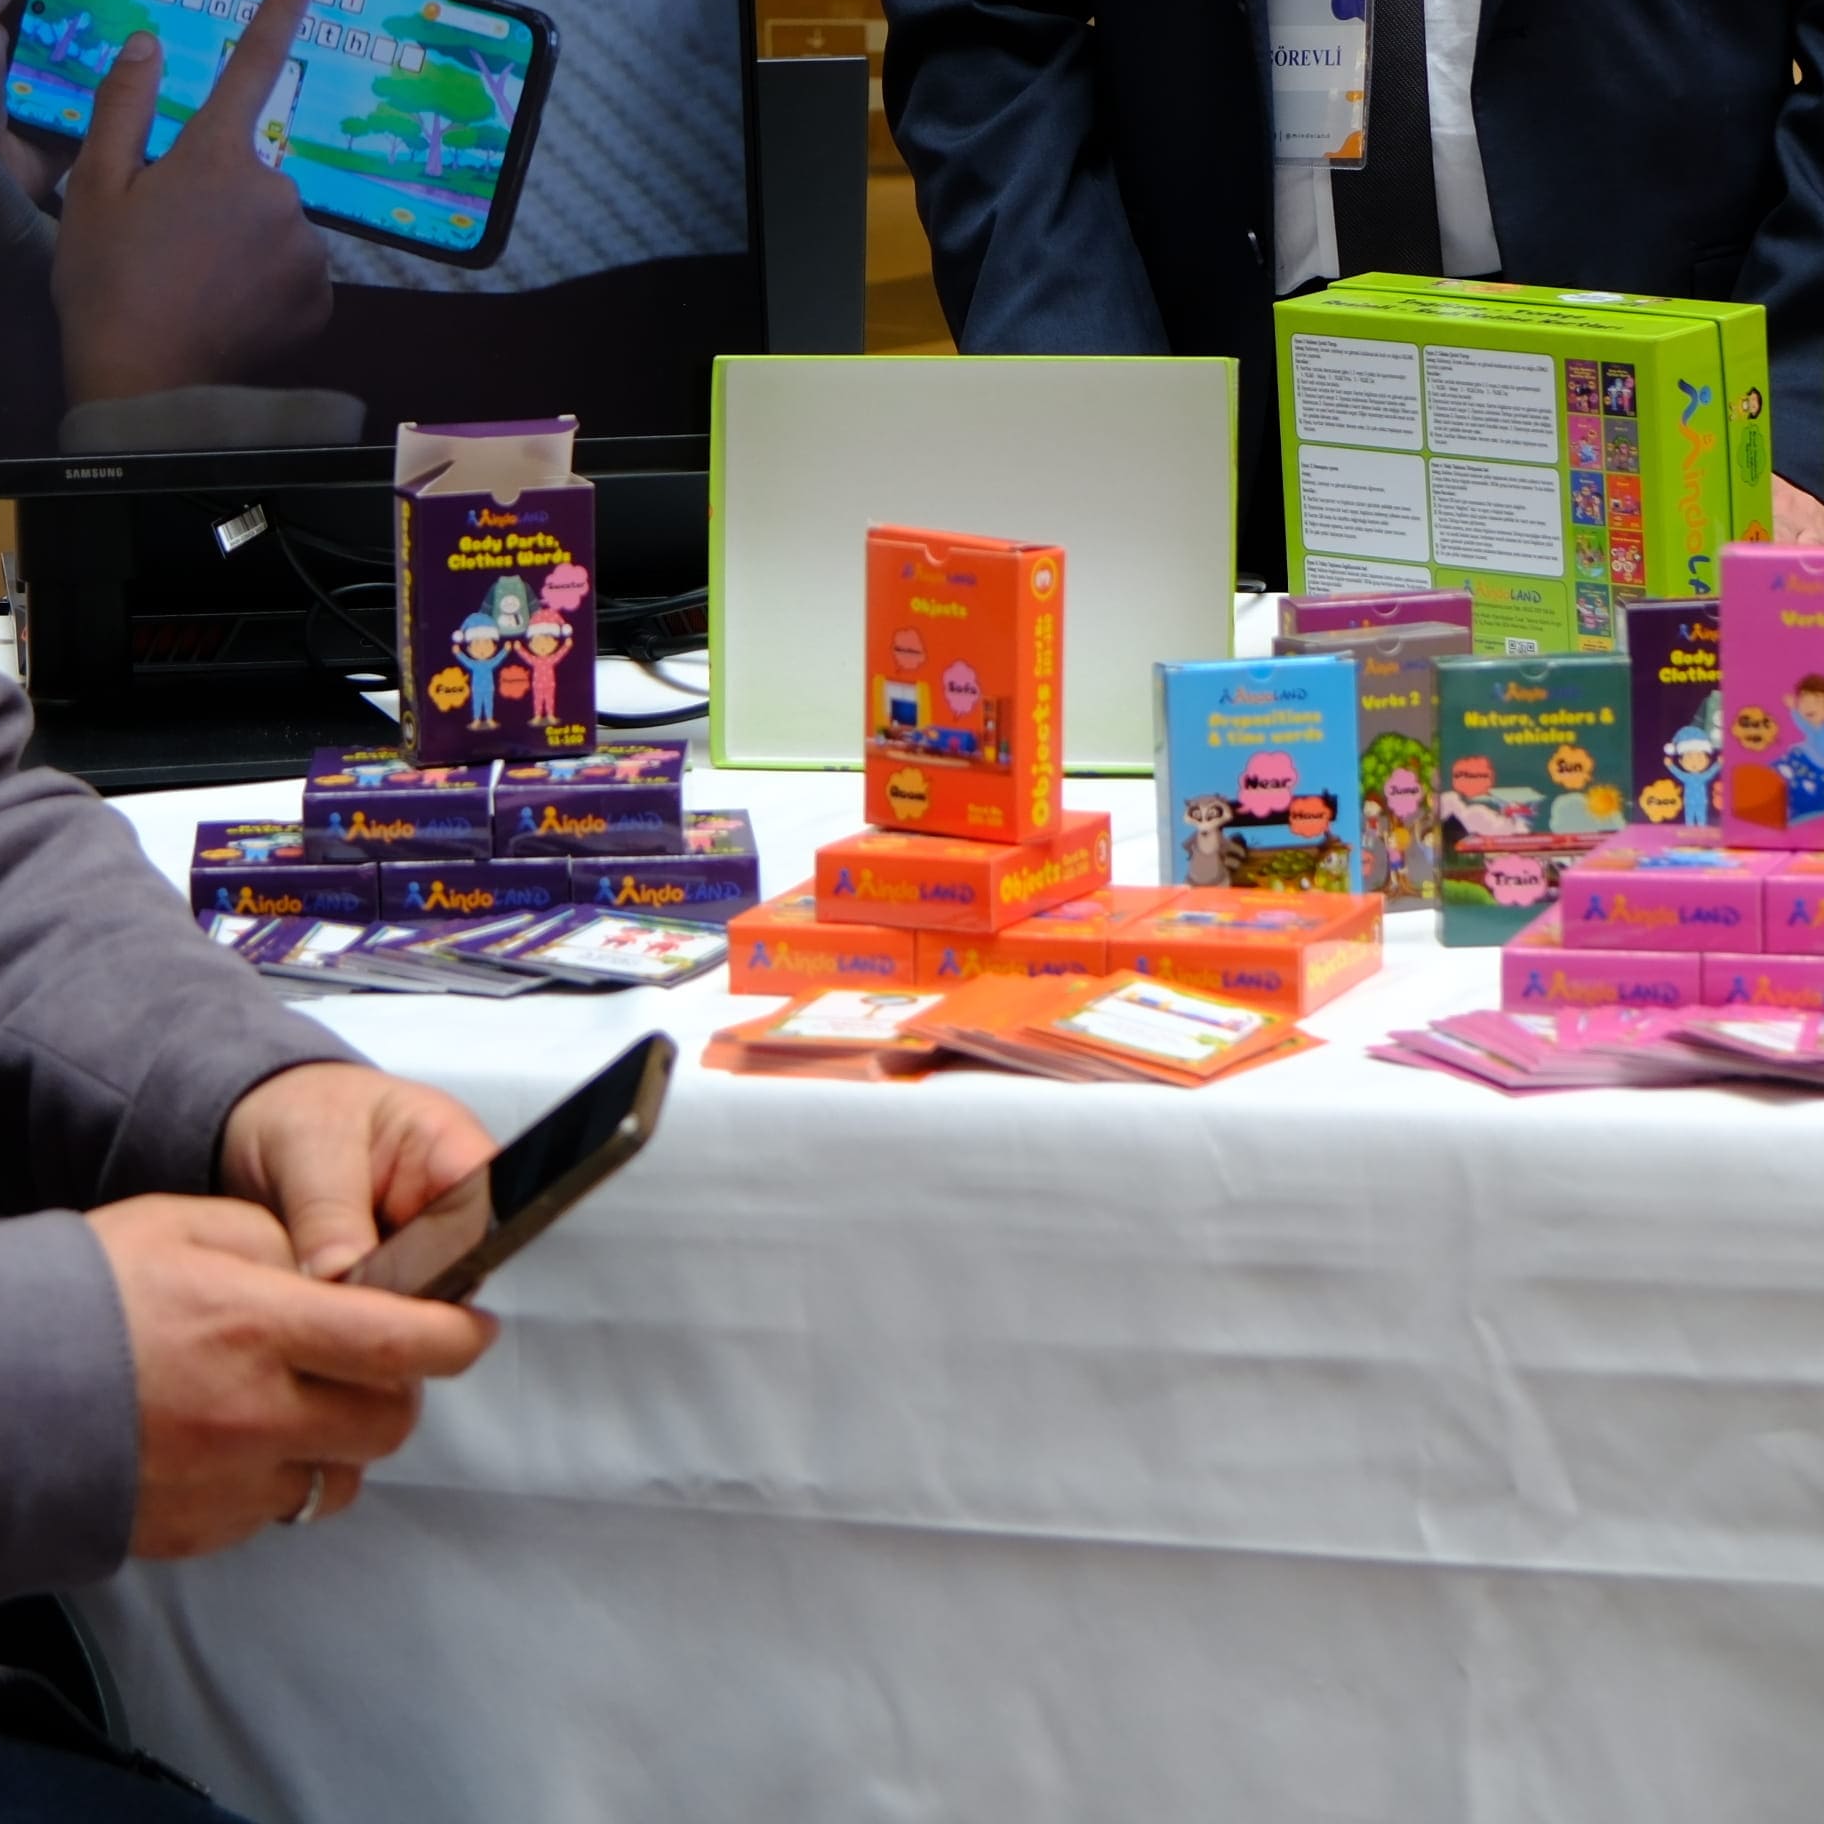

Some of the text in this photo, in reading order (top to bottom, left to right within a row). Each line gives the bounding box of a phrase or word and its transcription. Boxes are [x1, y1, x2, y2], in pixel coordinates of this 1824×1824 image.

[65, 467, 124, 479] SAMSUNG
[459, 531, 560, 554] Body Parts,
[447, 548, 571, 571] Clothes Words
[1671, 648, 1716, 667] Body
[1032, 683, 1054, 827] Objects
[1557, 760, 1583, 775] Sun
[1244, 775, 1291, 789] Near
[1493, 870, 1539, 887] Train
